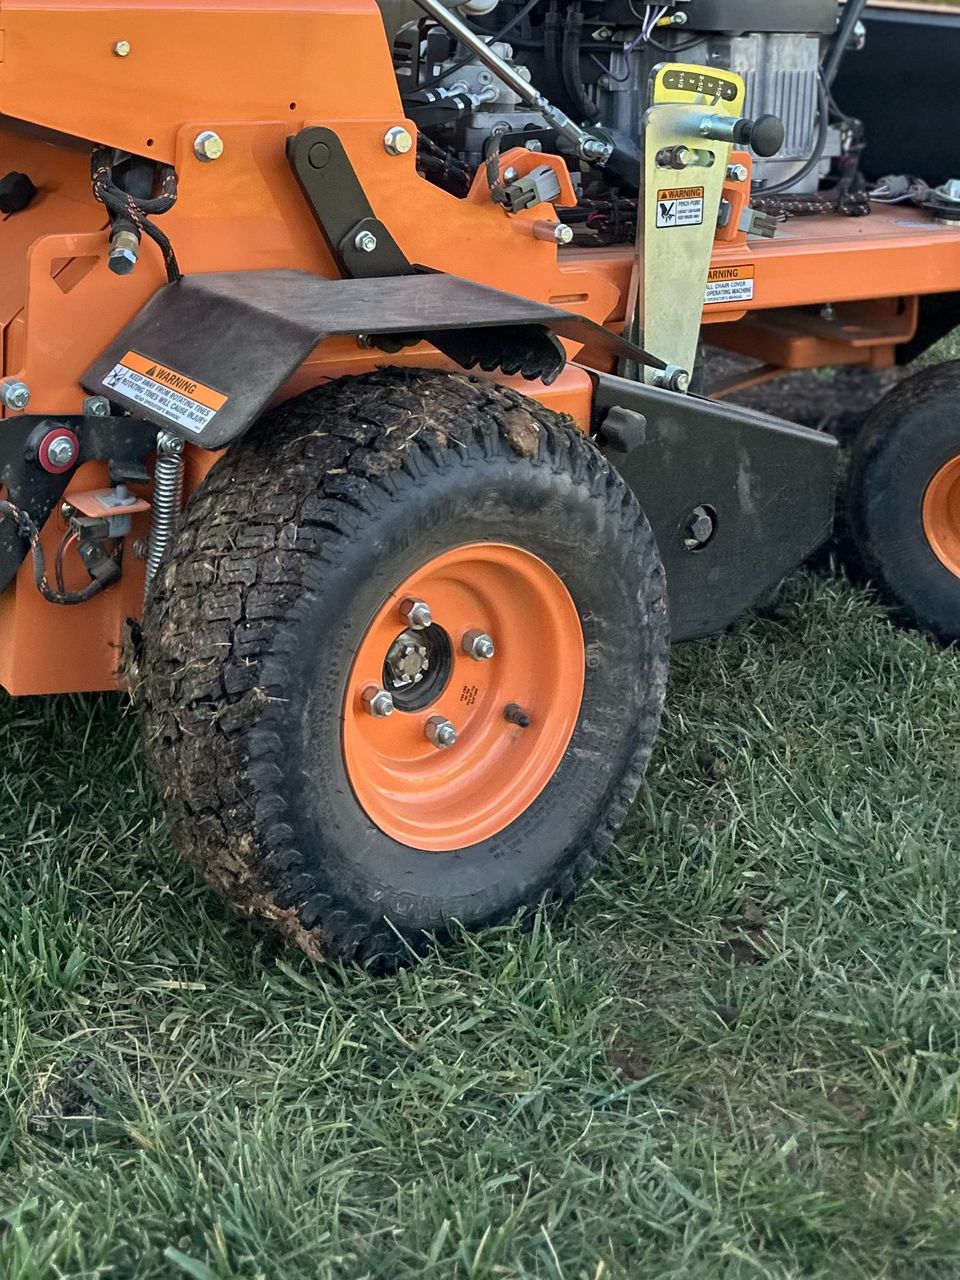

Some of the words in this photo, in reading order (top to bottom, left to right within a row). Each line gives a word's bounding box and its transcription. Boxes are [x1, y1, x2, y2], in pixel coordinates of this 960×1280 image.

[668, 188, 700, 198] WARNING
[707, 269, 738, 279] ARNING
[128, 372, 142, 384] KEEP
[141, 377, 156, 388] AWAY
[156, 384, 170, 395] FROM
[169, 389, 194, 408] ROTATING
[194, 401, 211, 416] TINES
[156, 368, 196, 394] WARNING
[121, 378, 145, 394] ROTATING
[145, 389, 159, 400] TINES
[159, 396, 171, 407] WILL
[171, 401, 188, 416] CAUSE
[187, 409, 206, 425] INJURY
